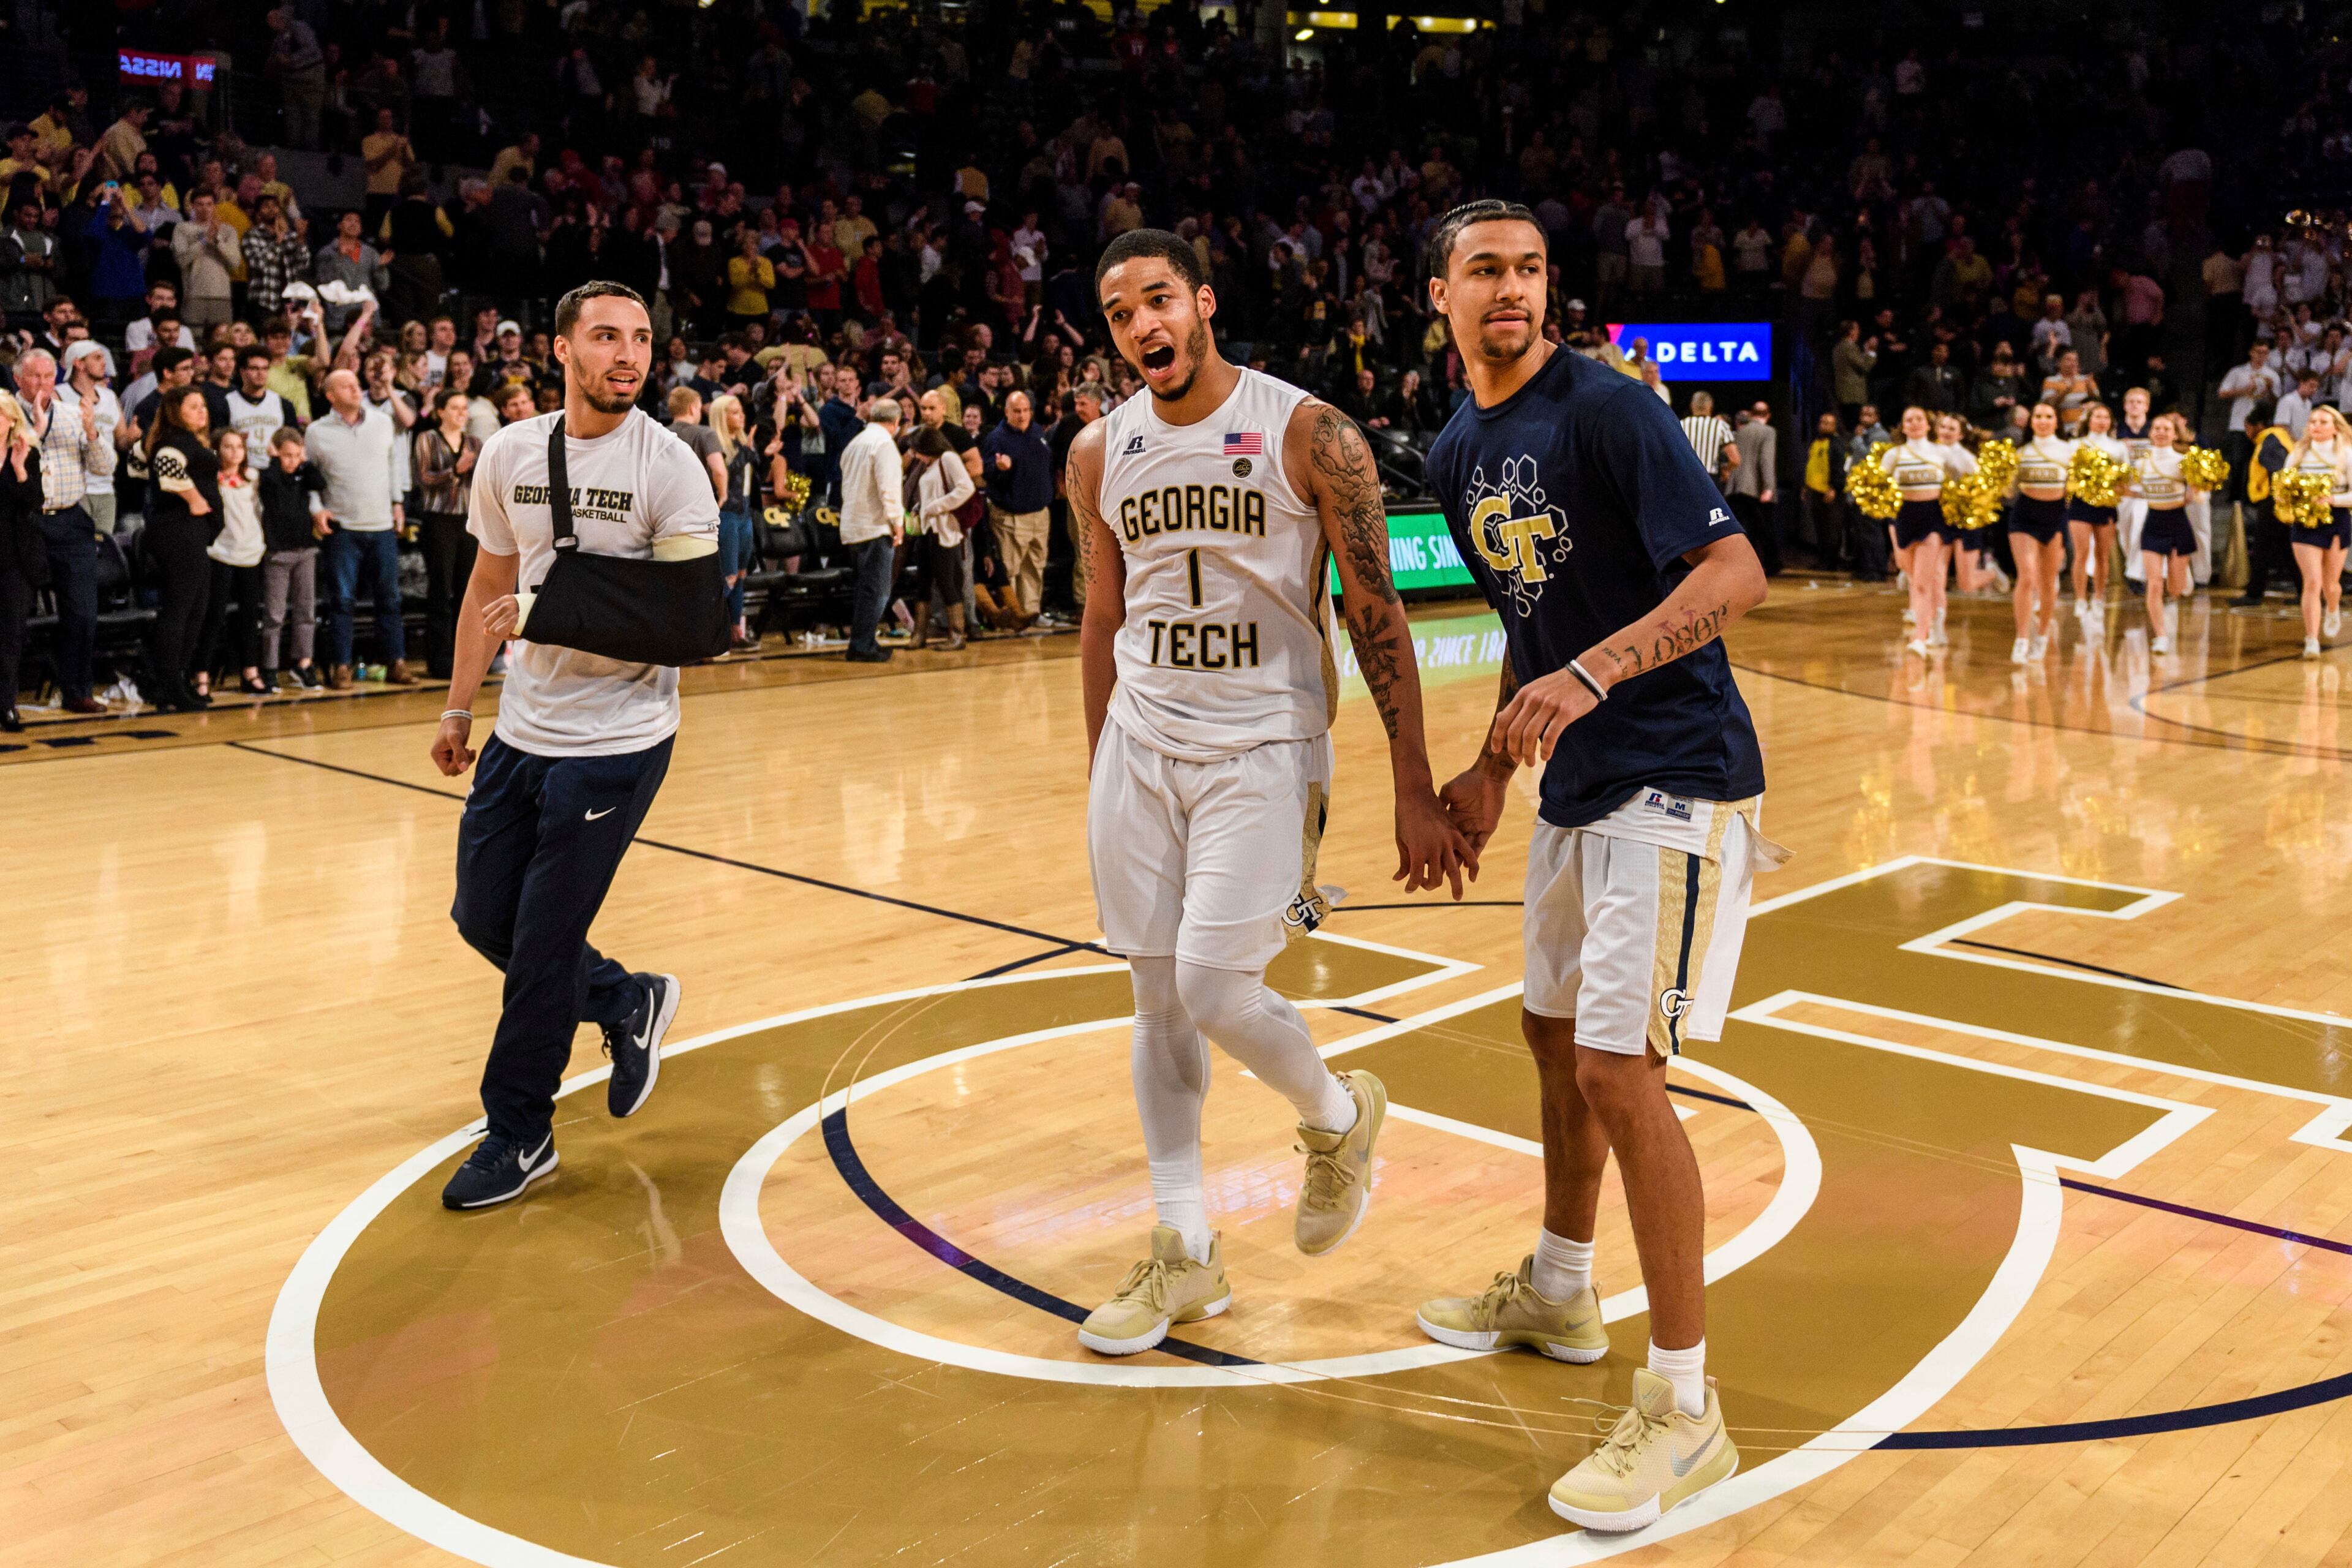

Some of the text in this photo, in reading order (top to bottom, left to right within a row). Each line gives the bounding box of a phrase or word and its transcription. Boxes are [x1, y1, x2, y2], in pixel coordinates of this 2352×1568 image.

[1656, 341, 1758, 362] DELTA
[1122, 444, 1146, 456] RUSSELL
[572, 508, 627, 524] ASKETBALL
[586, 488, 633, 511] TECH
[1119, 484, 1266, 544] GEORGIA
[1428, 535, 1466, 570] SIN
[1471, 491, 1556, 584] GT
[1186, 546, 1204, 609] 1
[1148, 619, 1261, 669] TECH
